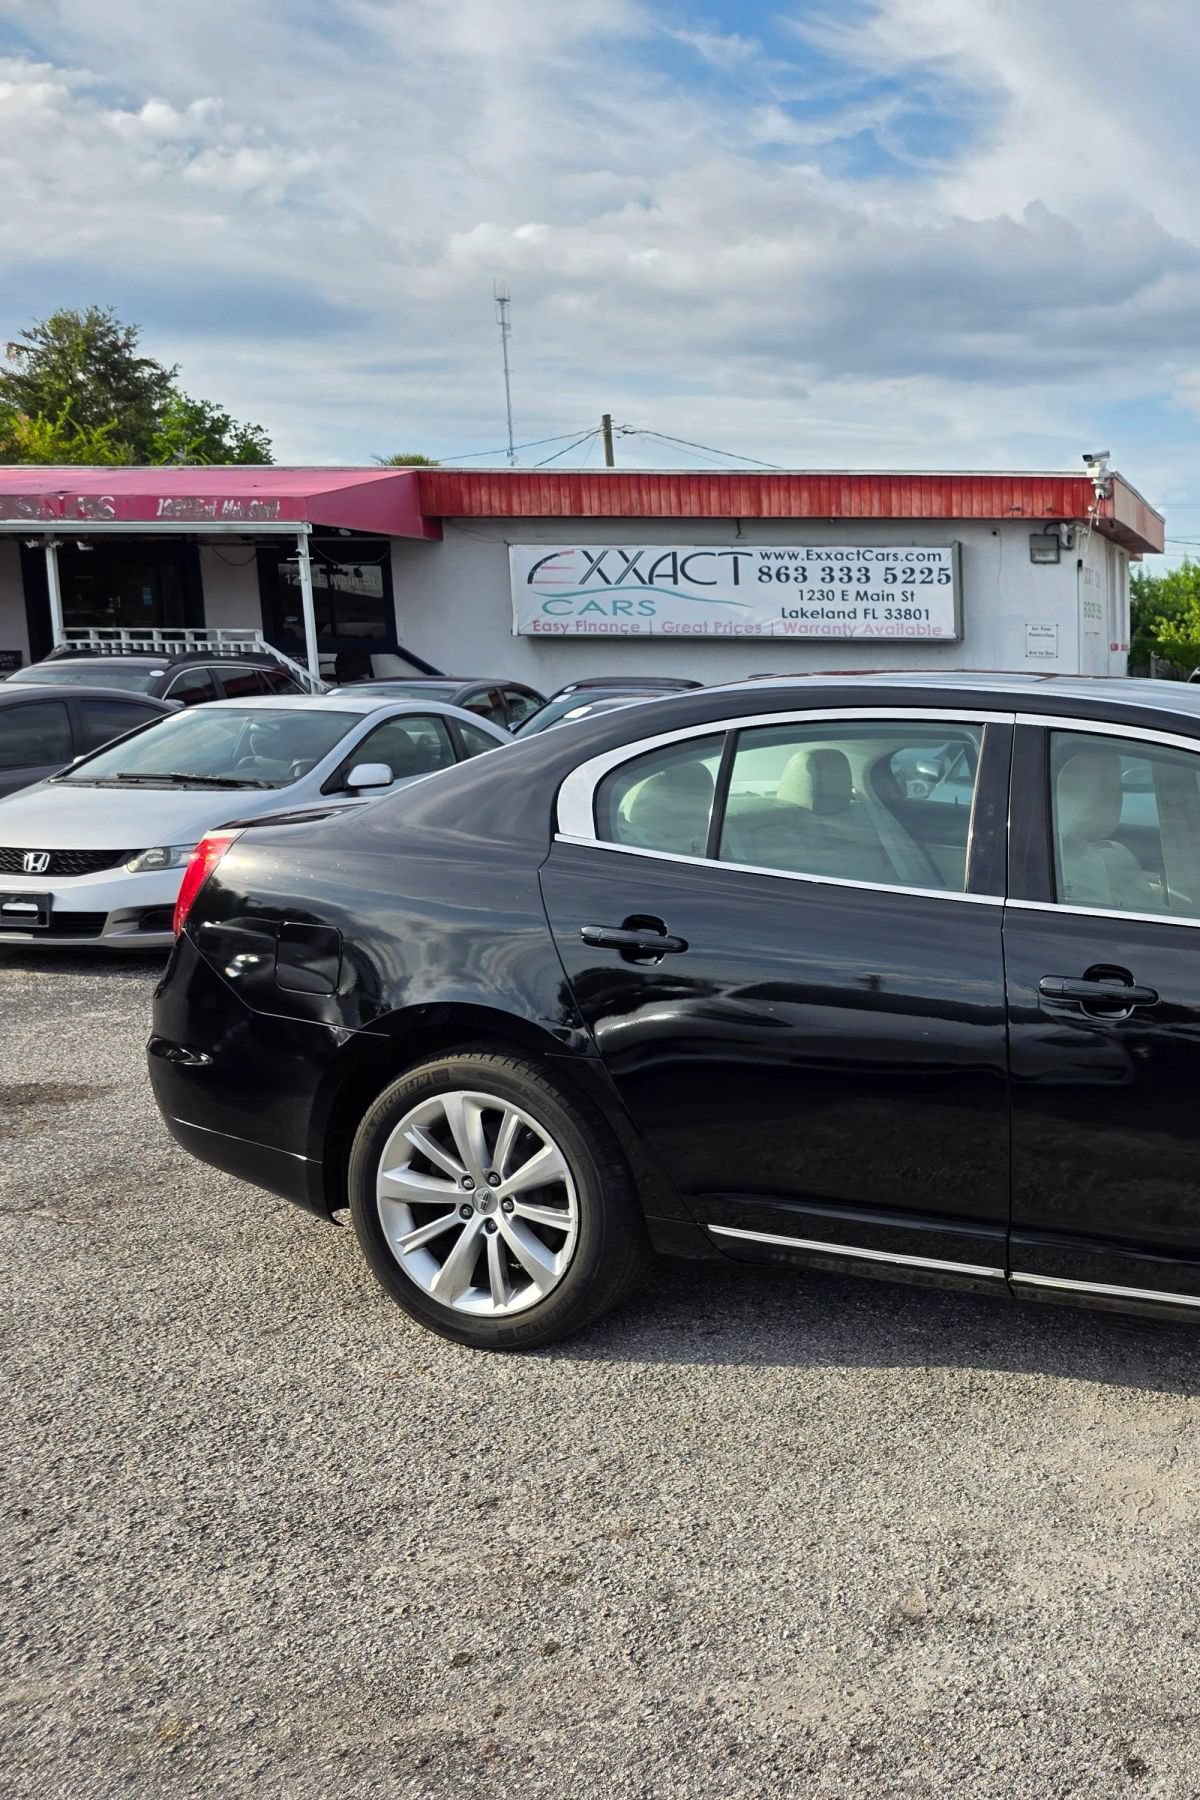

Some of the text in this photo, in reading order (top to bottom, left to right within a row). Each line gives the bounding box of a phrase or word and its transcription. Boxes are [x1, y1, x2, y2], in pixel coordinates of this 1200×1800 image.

[759, 549, 942, 562] www.ExxactCars.com
[527, 549, 753, 586] EXXACT
[757, 565, 951, 585] 863 333 5225
[798, 589, 915, 602] 1230 E Main St
[541, 599, 657, 617] CARS
[781, 607, 930, 621] Lakeland FL 33801
[532, 620, 942, 637] Easy Finance Great Prices Warranty Available
